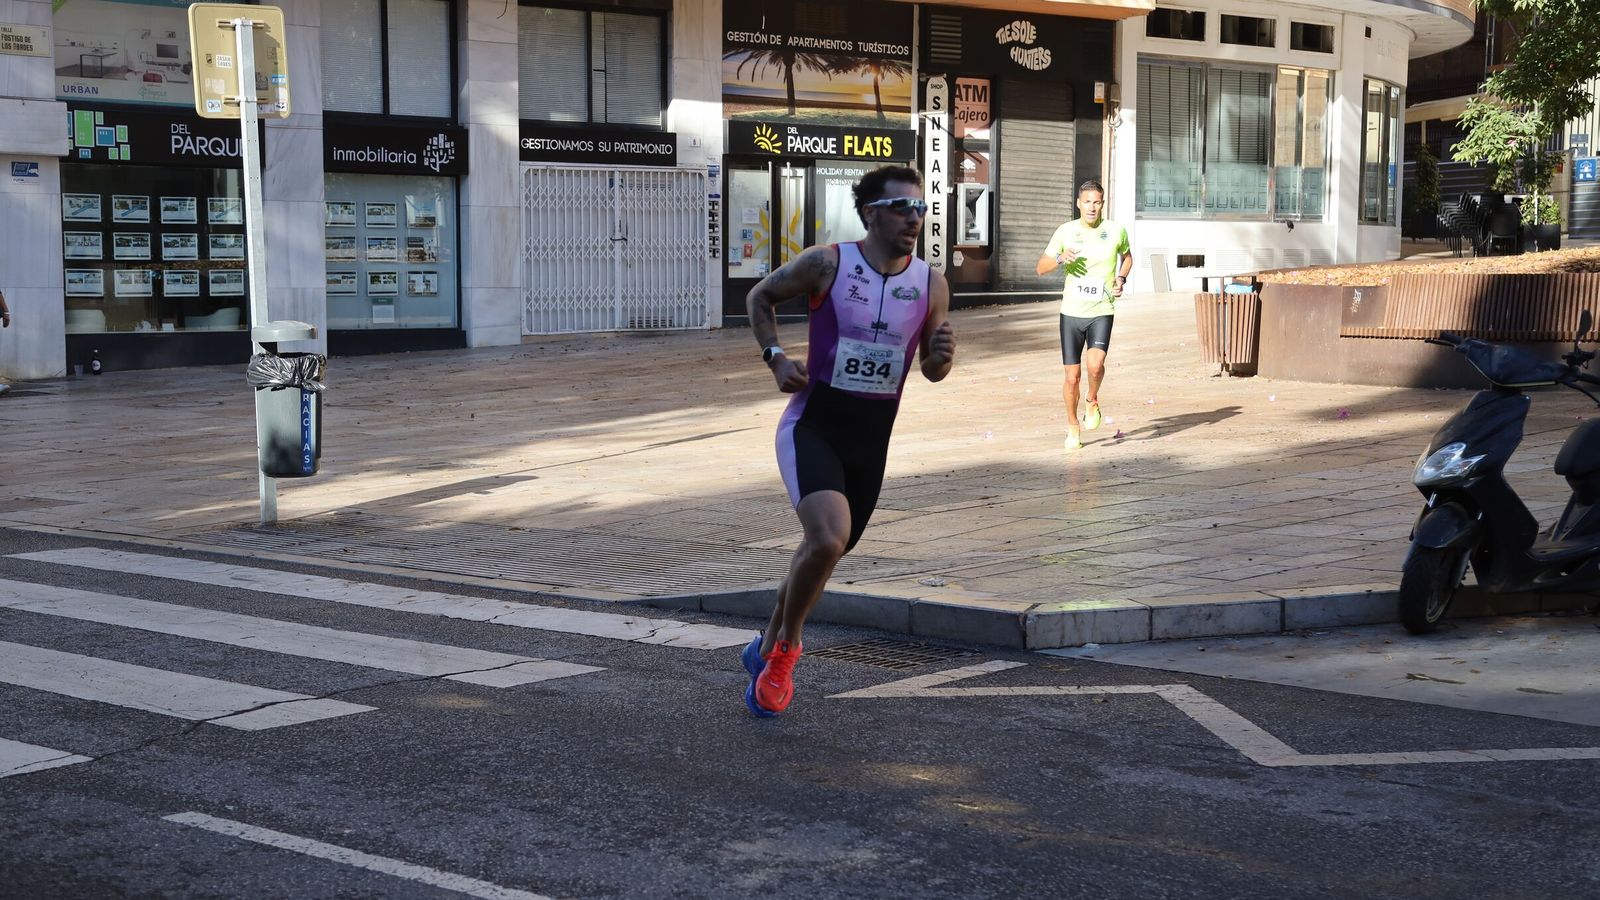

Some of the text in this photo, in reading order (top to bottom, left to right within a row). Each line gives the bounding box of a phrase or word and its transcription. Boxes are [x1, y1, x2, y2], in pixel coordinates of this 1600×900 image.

[996, 20, 1037, 44] THE SOLE
[727, 31, 909, 55] GESTIÓN DE APARTAMENTOS TURÍSTICOS
[1010, 46, 1052, 71] HUNTERS
[63, 84, 98, 95] URBAN
[955, 84, 988, 103] ATM
[171, 123, 191, 135] DEL
[787, 126, 799, 135] DEL
[171, 135, 243, 157] PARQU
[333, 146, 417, 164] inmobiliaria
[520, 137, 673, 155] GESTIONAMOS SU PATRIMONIO
[787, 135, 893, 157] PARQUE FLATS
[816, 167, 843, 176] HOLIDAY
[844, 168, 864, 176] RENTAL
[932, 96, 941, 257] SNEAKERS
[1077, 285, 1097, 295] 148
[844, 357, 891, 379] 834
